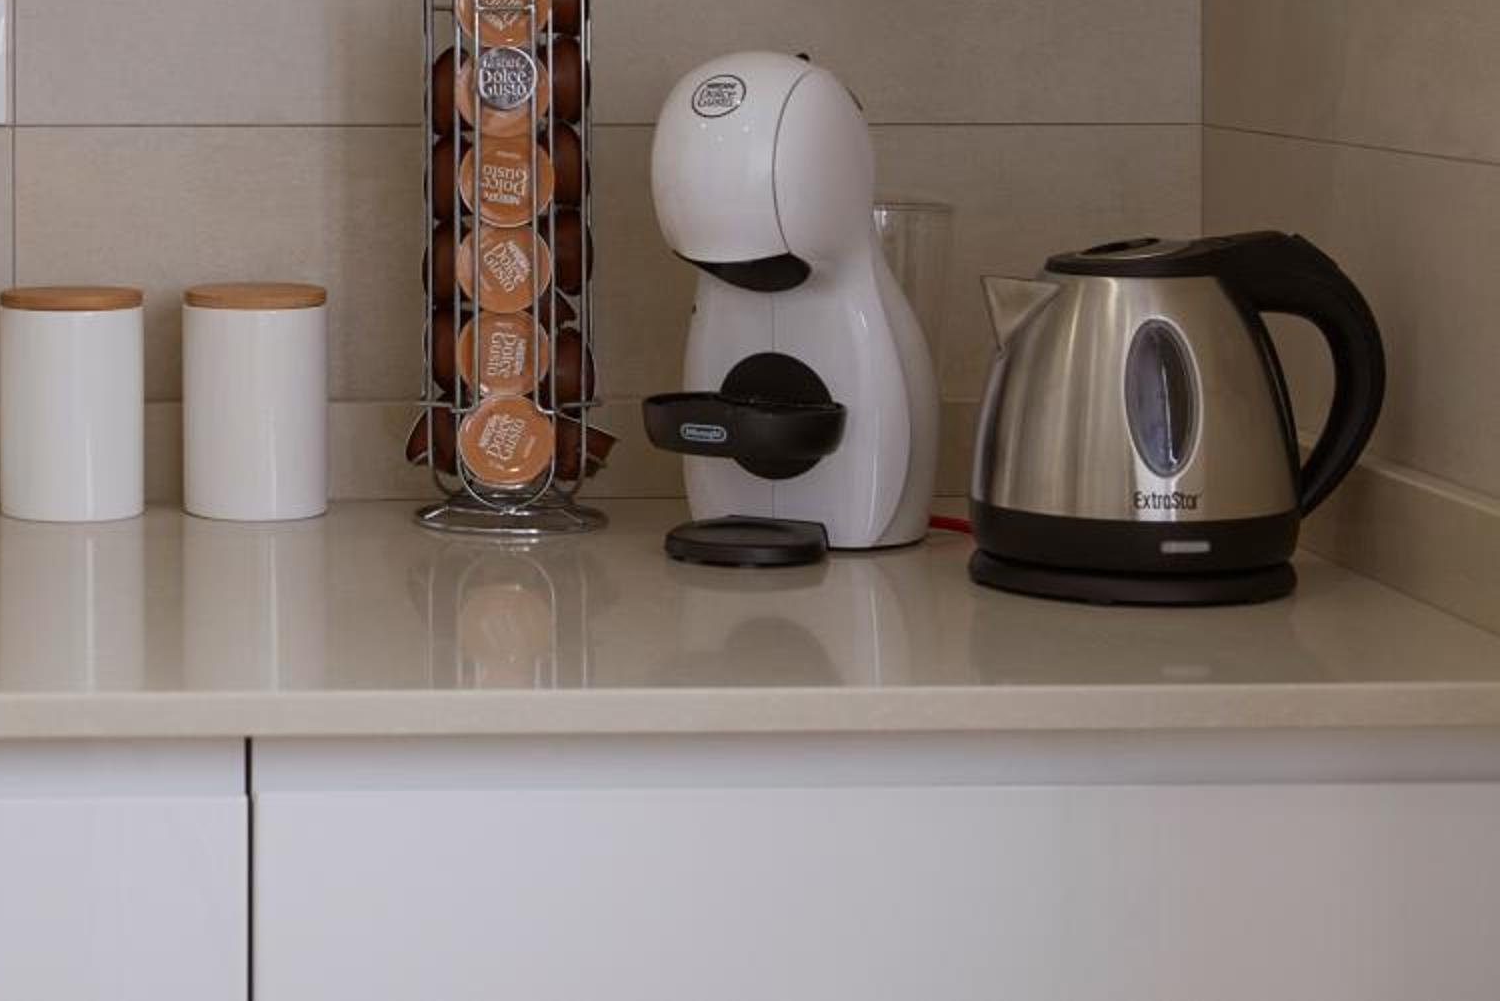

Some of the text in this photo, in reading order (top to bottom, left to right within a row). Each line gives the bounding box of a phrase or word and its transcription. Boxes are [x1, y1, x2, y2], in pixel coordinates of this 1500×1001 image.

[483, 165, 527, 182] Gusto
[487, 333, 505, 375] Gusto
[1133, 490, 1198, 510] ExtraStar
